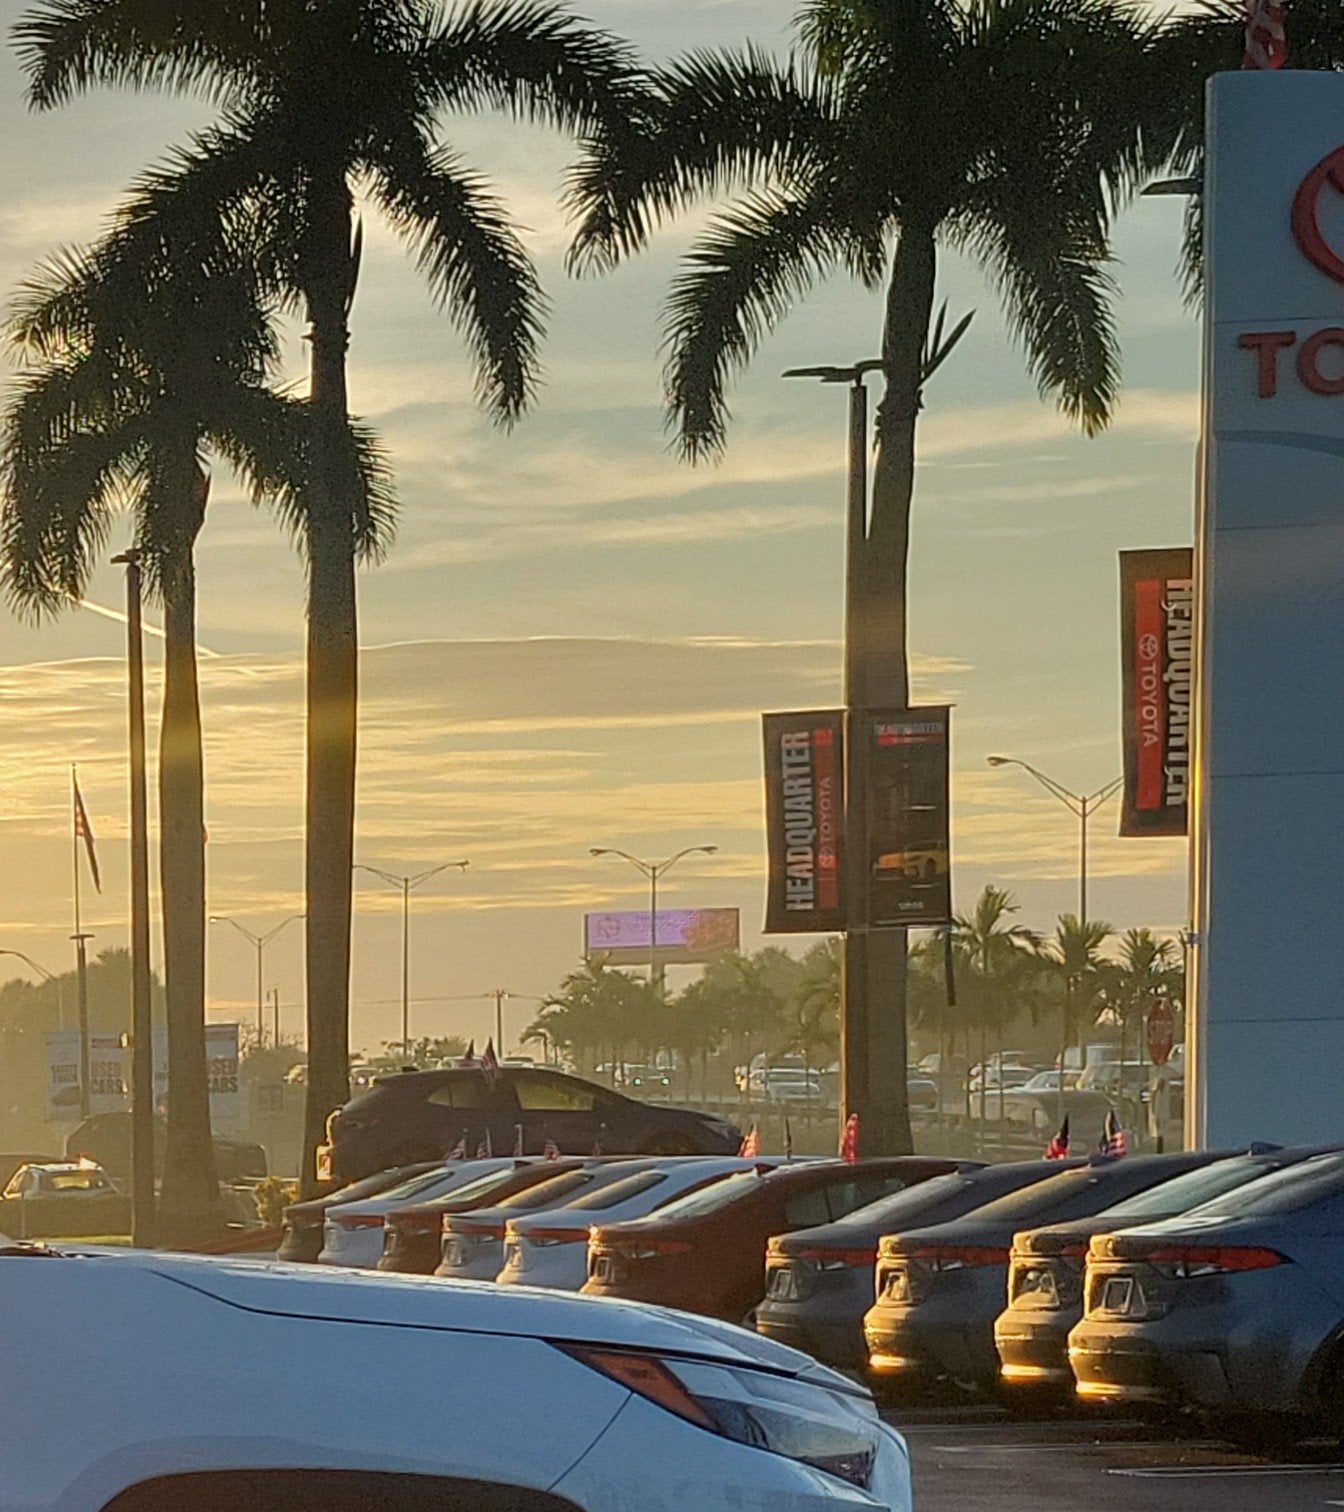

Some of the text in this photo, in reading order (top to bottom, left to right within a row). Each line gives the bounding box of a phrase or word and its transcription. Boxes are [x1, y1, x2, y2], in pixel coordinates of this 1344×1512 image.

[1140, 662, 1158, 748] TOYOTA
[781, 731, 816, 911] HEADQUARTER
[818, 776, 835, 844] TOYOTA
